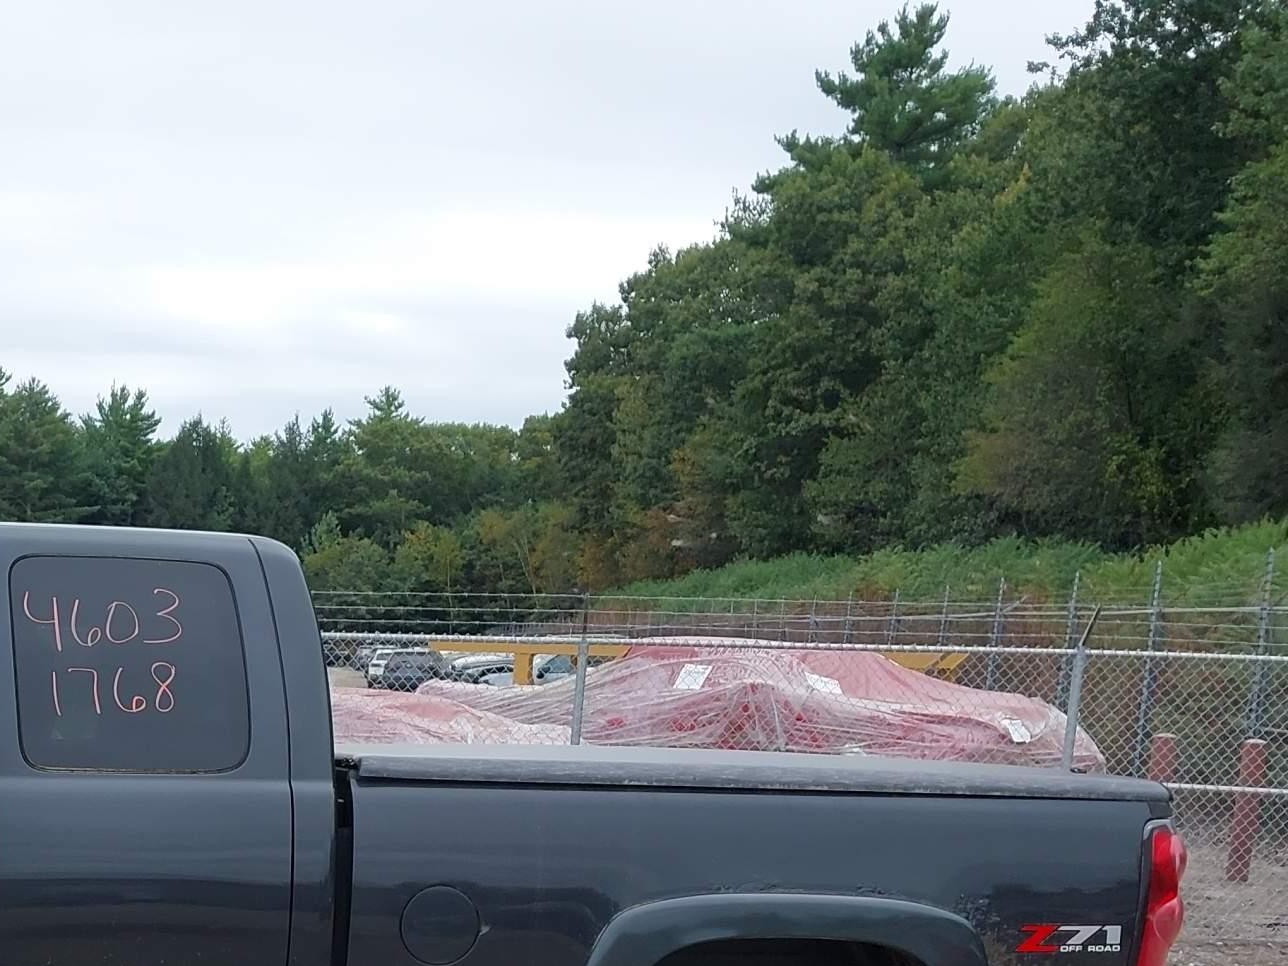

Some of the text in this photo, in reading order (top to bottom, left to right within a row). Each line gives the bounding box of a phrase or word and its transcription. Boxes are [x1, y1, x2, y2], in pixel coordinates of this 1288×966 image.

[23, 588, 182, 652] 4603
[51, 661, 176, 716] 1768
[1015, 924, 1122, 953] Z71
[1060, 945, 1083, 953] OFF
